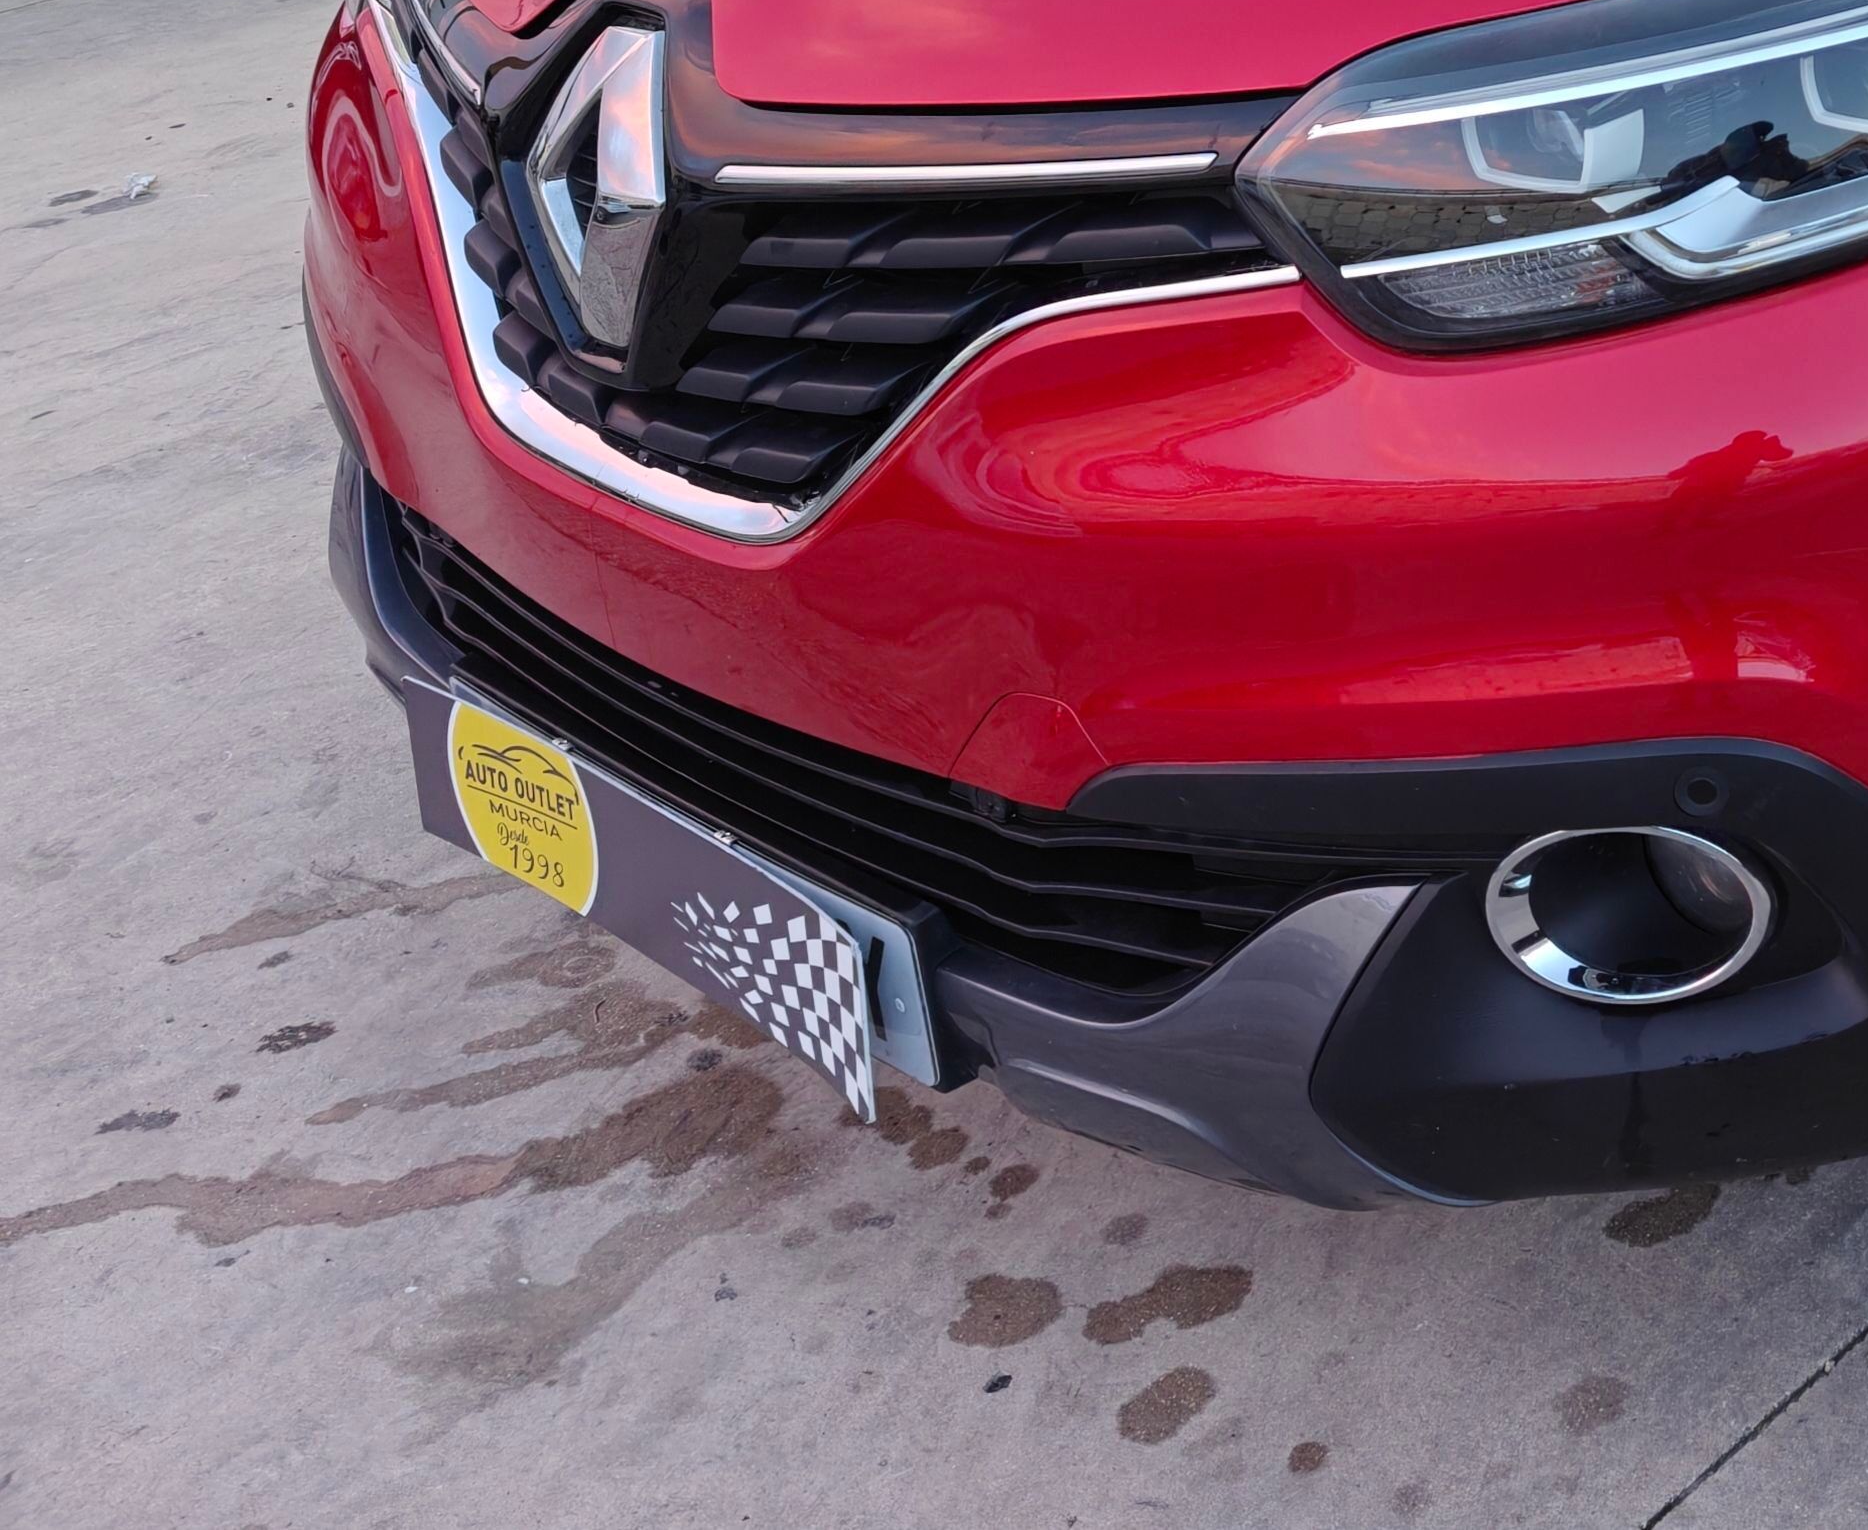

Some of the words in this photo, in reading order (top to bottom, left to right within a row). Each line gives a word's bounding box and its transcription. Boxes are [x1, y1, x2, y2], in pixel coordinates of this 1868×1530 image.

[465, 759, 508, 793] AUTO
[514, 776, 575, 820] OUTLET
[488, 799, 563, 841] MURCIA
[510, 844, 565, 888] 1998
